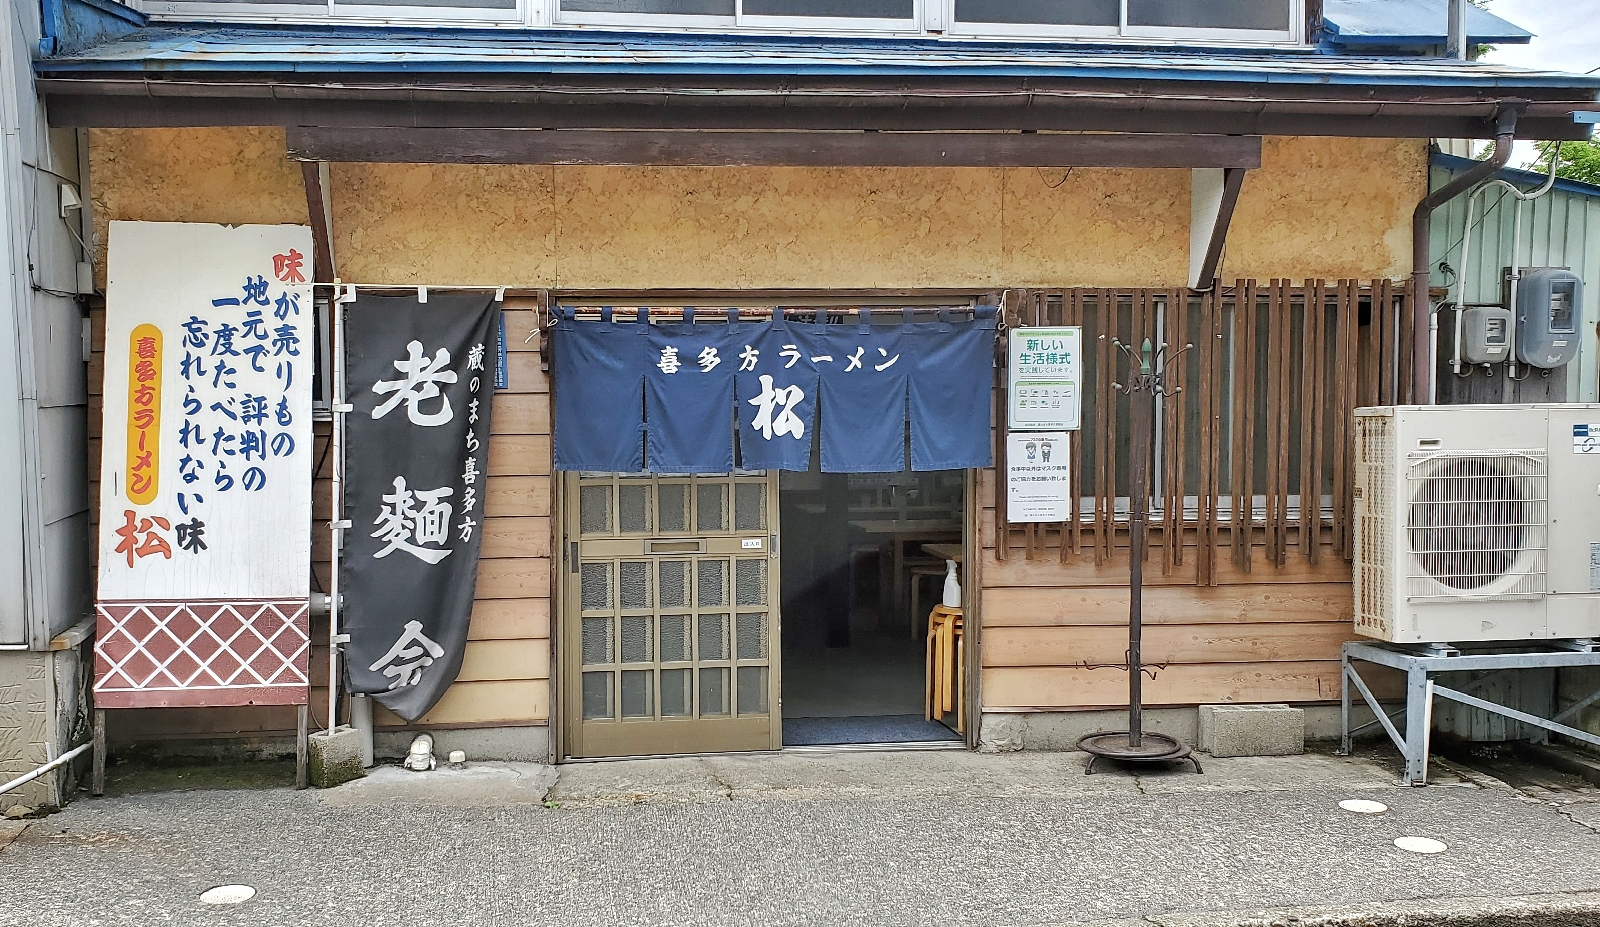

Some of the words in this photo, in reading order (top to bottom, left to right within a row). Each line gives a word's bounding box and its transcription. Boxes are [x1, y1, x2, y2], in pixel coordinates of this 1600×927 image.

[209, 297, 241, 492] 一度たべたら
[270, 248, 306, 458] 味が売りもの
[655, 343, 900, 375] 喜多方ラーメン
[1019, 352, 1071, 365] 生活様式
[1026, 339, 1064, 351] 新しい
[130, 336, 158, 495] 喜多方ラーメン
[175, 316, 209, 555] 忘れられない味
[458, 344, 488, 543] 蔵のまち喜多方
[747, 374, 805, 441] 松
[114, 510, 172, 569] 松
